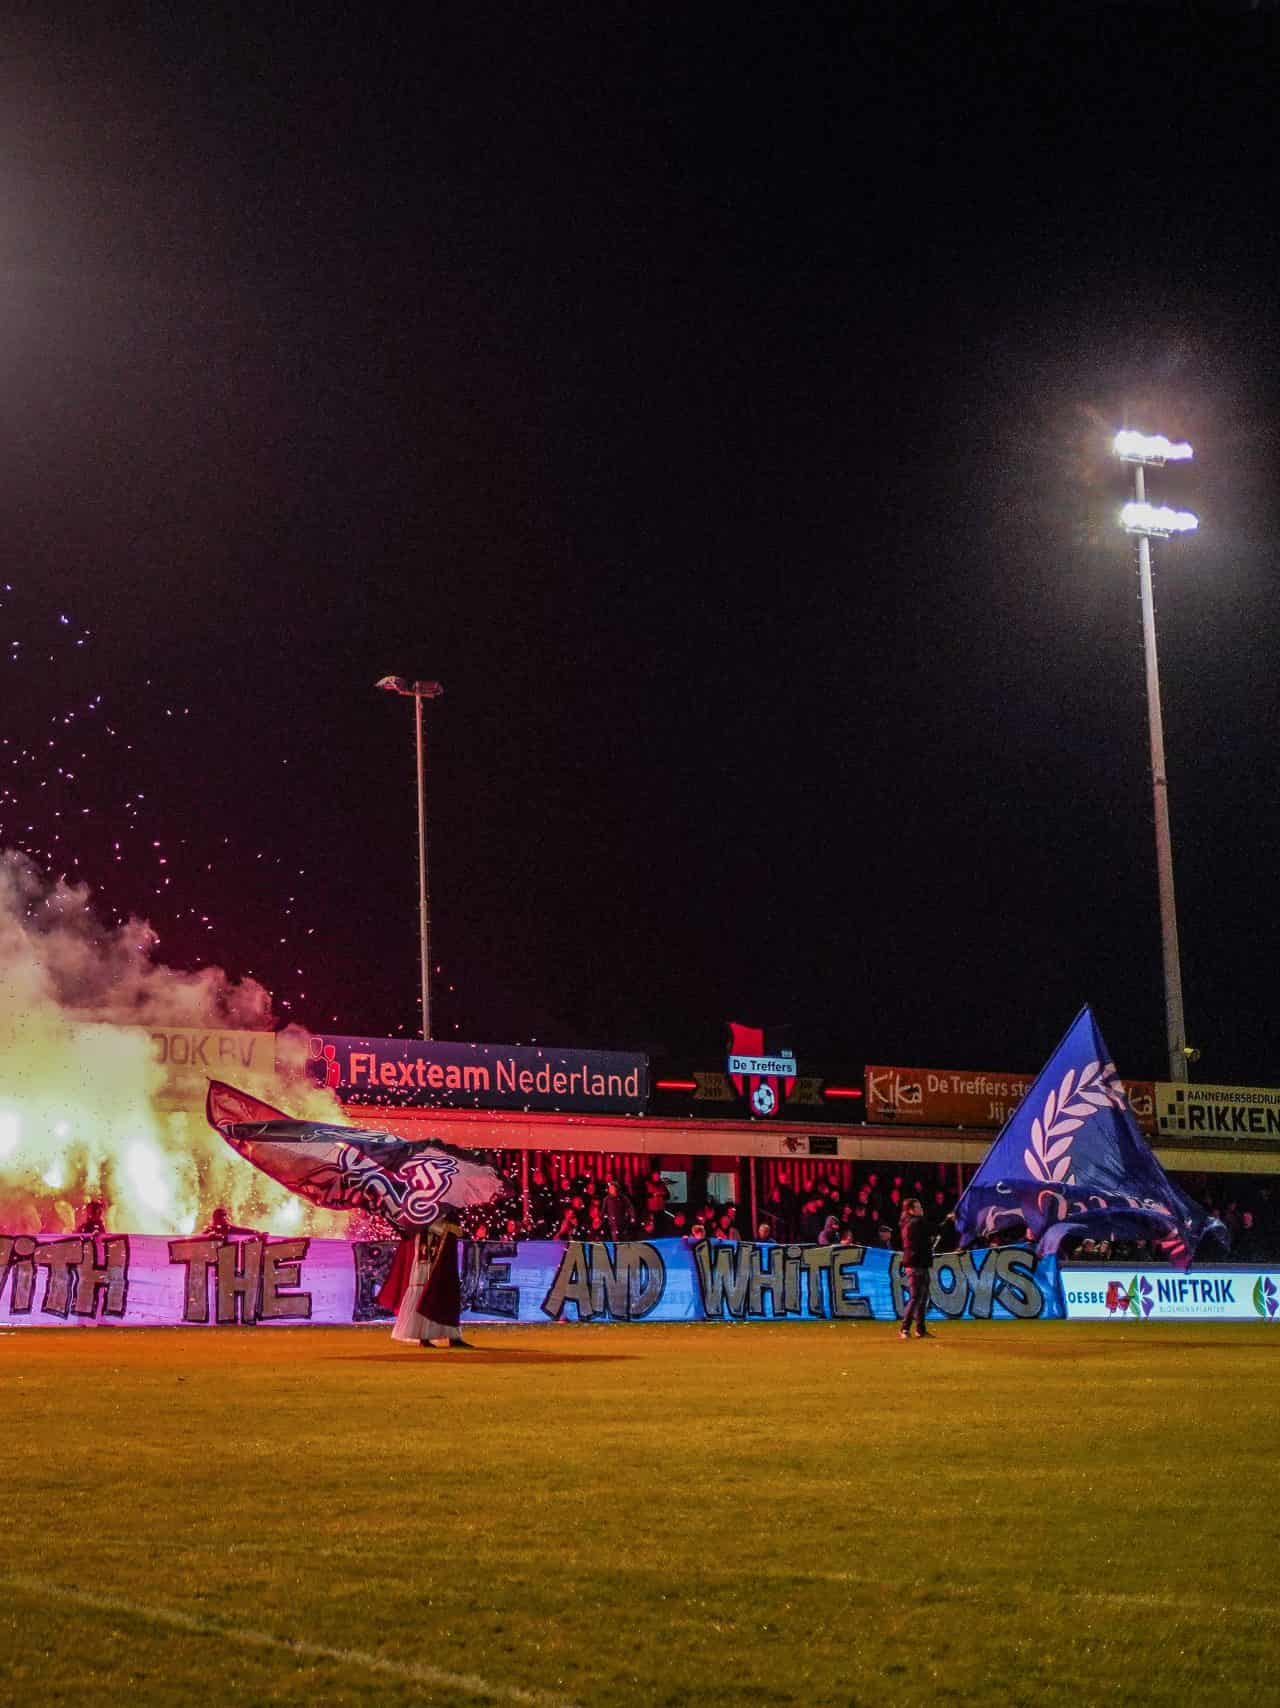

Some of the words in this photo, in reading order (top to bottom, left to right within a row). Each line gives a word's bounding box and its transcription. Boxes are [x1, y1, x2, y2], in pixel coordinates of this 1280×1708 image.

[349, 1052, 490, 1090] Flexteam
[496, 1060, 639, 1097] Nederland
[733, 1059, 747, 1070] De
[750, 1060, 793, 1073] Treffers
[927, 1074, 948, 1093] De
[949, 1076, 1008, 1096] Treffers
[1187, 1091, 1280, 1105] AANNEMERSBEDRIJ
[1188, 1104, 1280, 1133] RIKKEN
[167, 1237, 313, 1325] THE
[539, 1240, 666, 1321] AND
[1157, 1279, 1235, 1303] NIFTRIK
